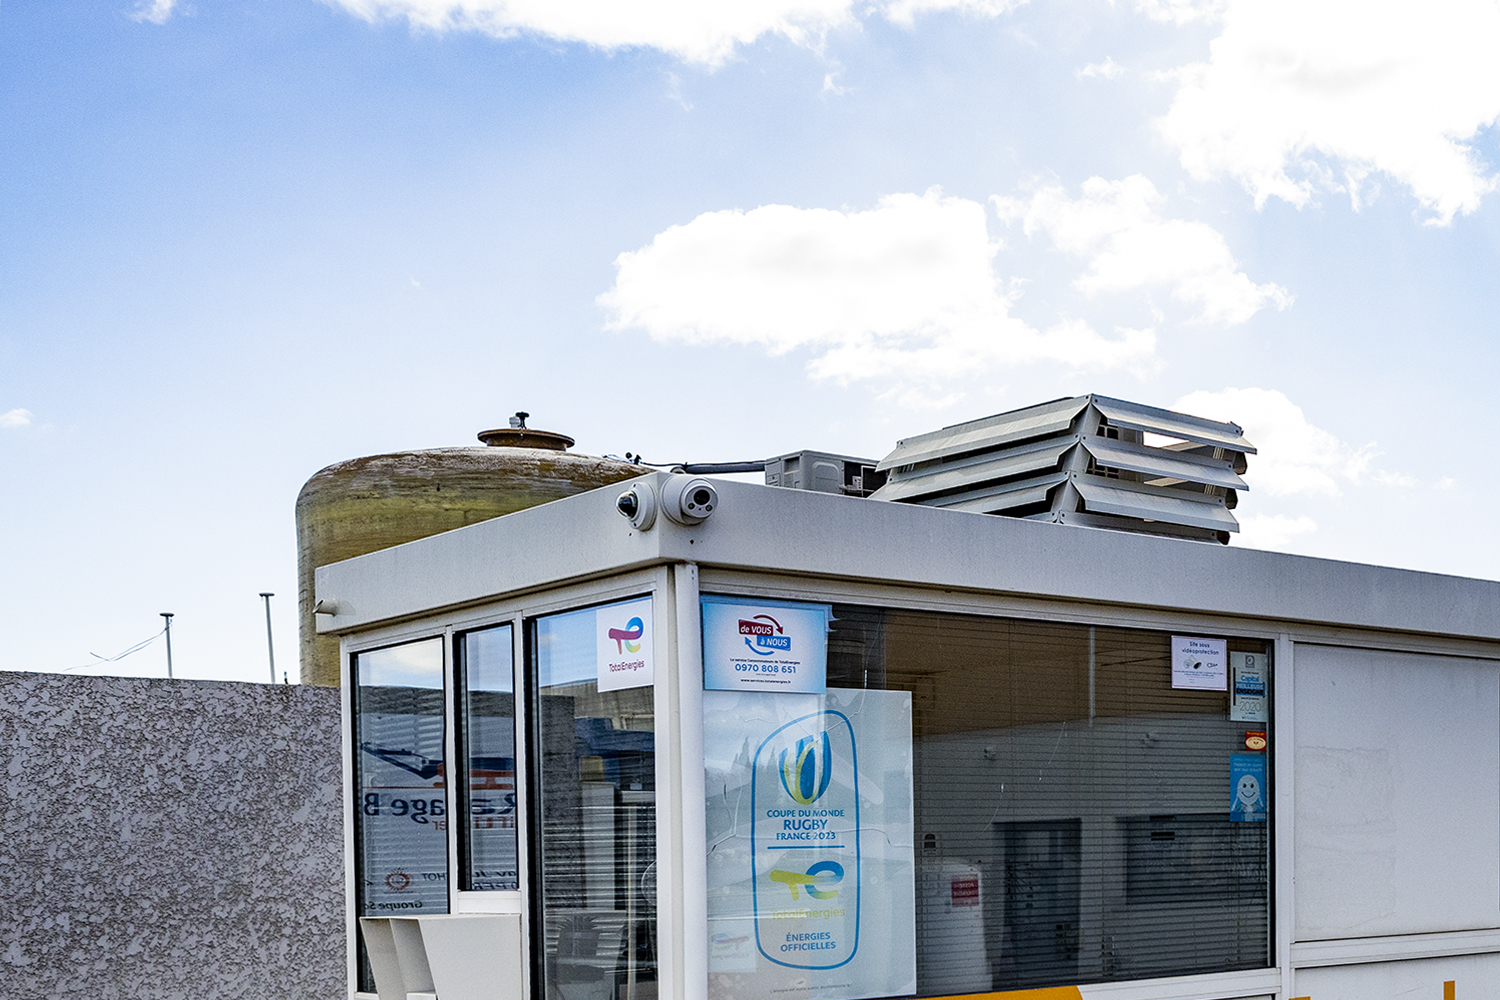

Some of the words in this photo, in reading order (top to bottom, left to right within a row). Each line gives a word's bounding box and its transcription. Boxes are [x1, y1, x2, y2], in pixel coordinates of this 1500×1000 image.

[740, 625, 750, 634] de
[751, 625, 773, 635] VOUS
[766, 637, 788, 647] NOUS
[609, 659, 645, 673] TotalEnergies
[735, 663, 759, 672] 0970
[761, 664, 779, 673] 808
[781, 665, 797, 674] 651
[1240, 701, 1261, 712] 2020
[766, 810, 797, 818] COUPE
[812, 809, 845, 817] MONDE
[783, 819, 828, 831] RUGBY
[776, 832, 811, 840] FRANCE
[812, 832, 836, 840] 2023
[771, 907, 845, 920] TotalEnergies
[786, 932, 831, 942] ÉNERGIES
[780, 941, 836, 952] OFFICIELLES
